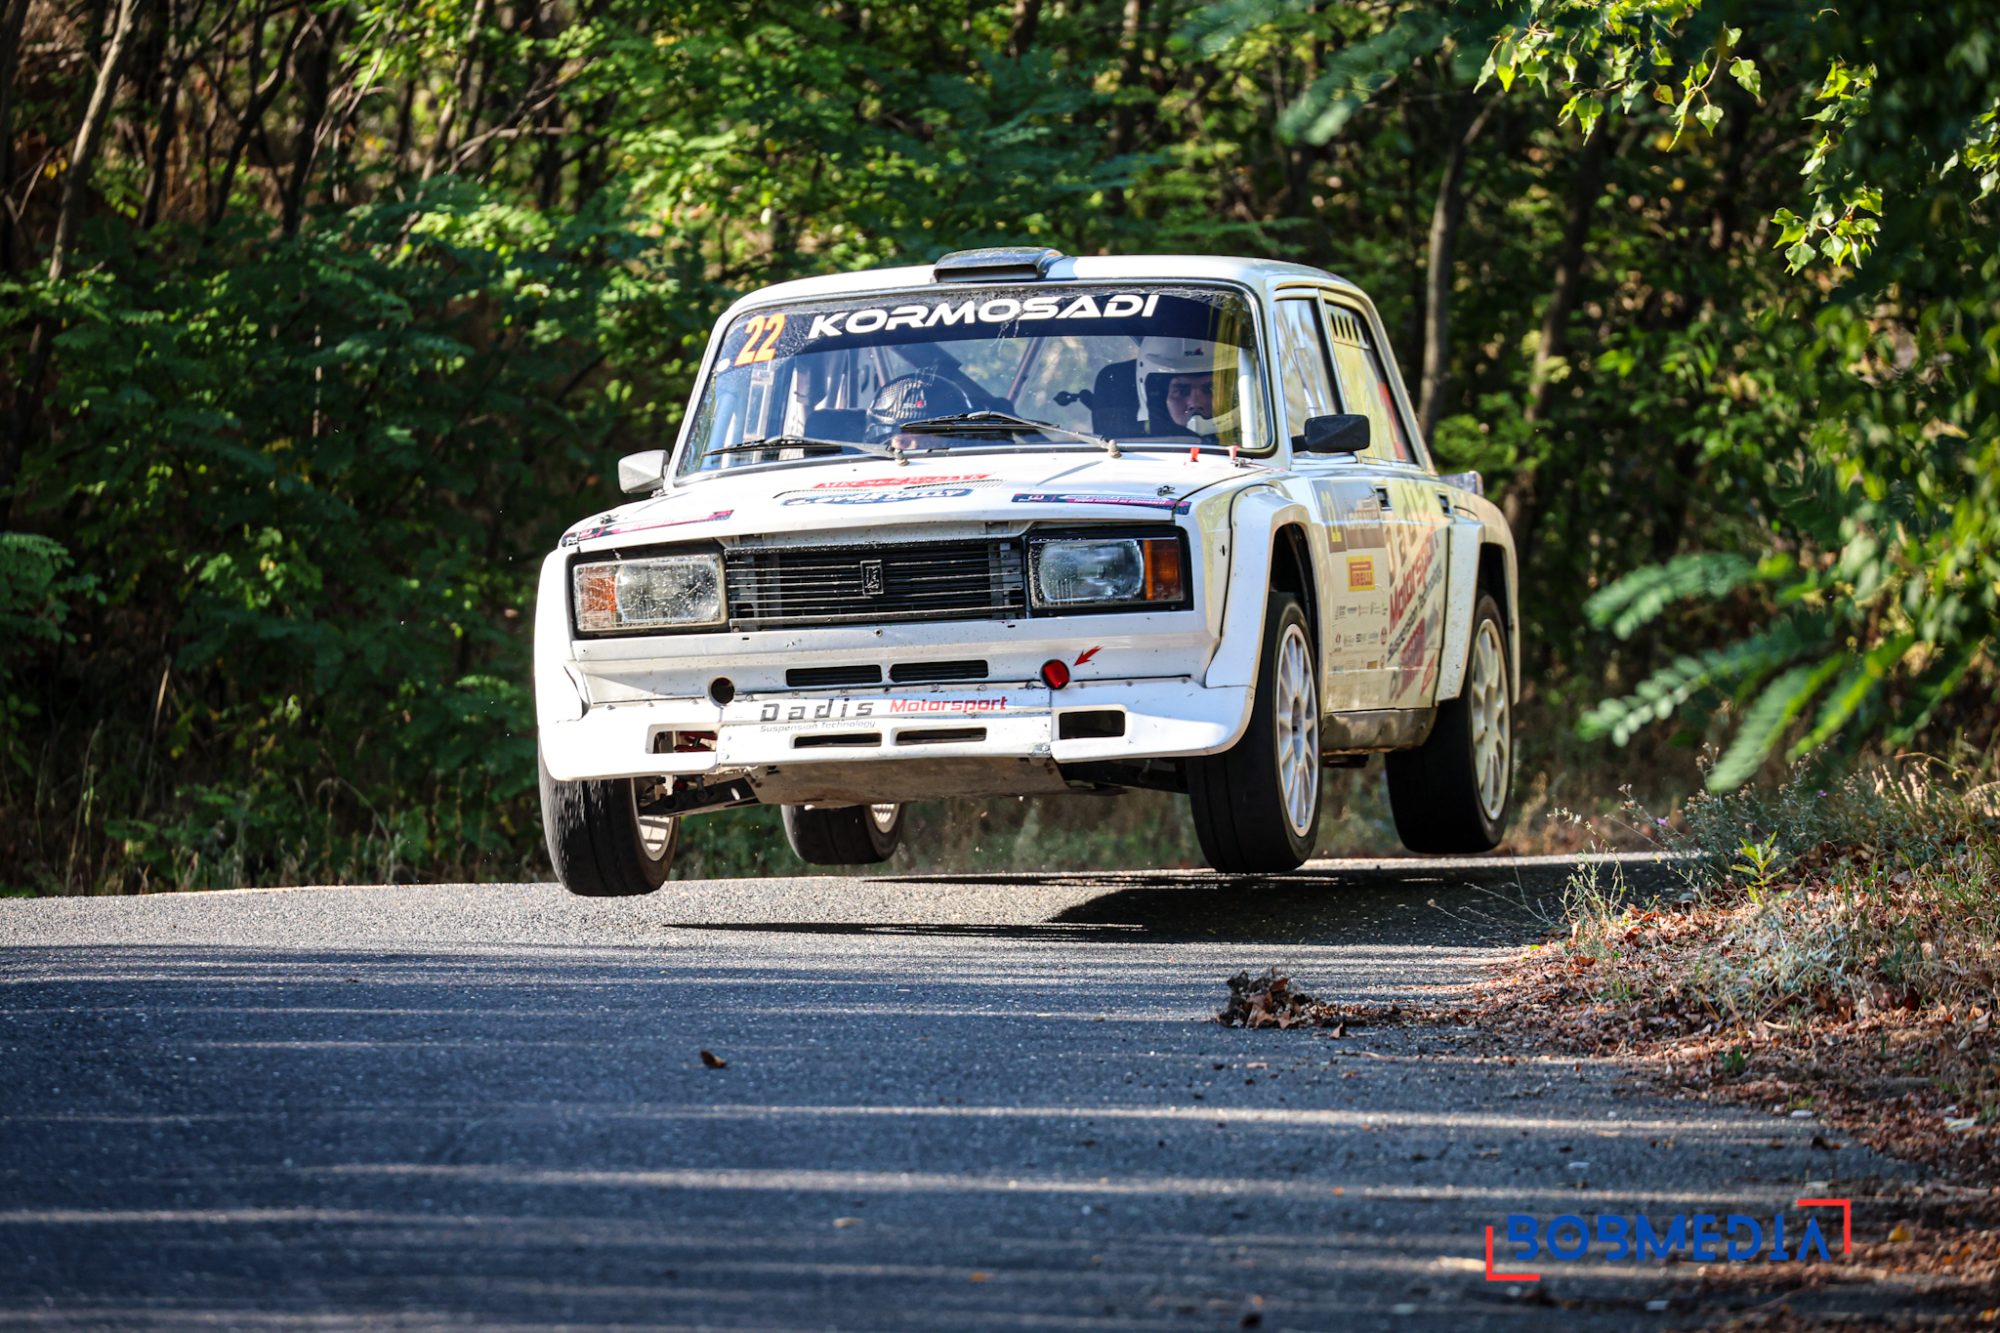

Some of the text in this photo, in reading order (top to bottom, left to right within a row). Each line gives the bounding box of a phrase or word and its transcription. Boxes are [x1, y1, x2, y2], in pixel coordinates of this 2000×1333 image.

[807, 293, 1160, 340] KORMOSADI
[735, 313, 787, 367] 22
[760, 695, 1008, 722] Dadis Motorsport
[760, 719, 876, 734] Suspension Technology
